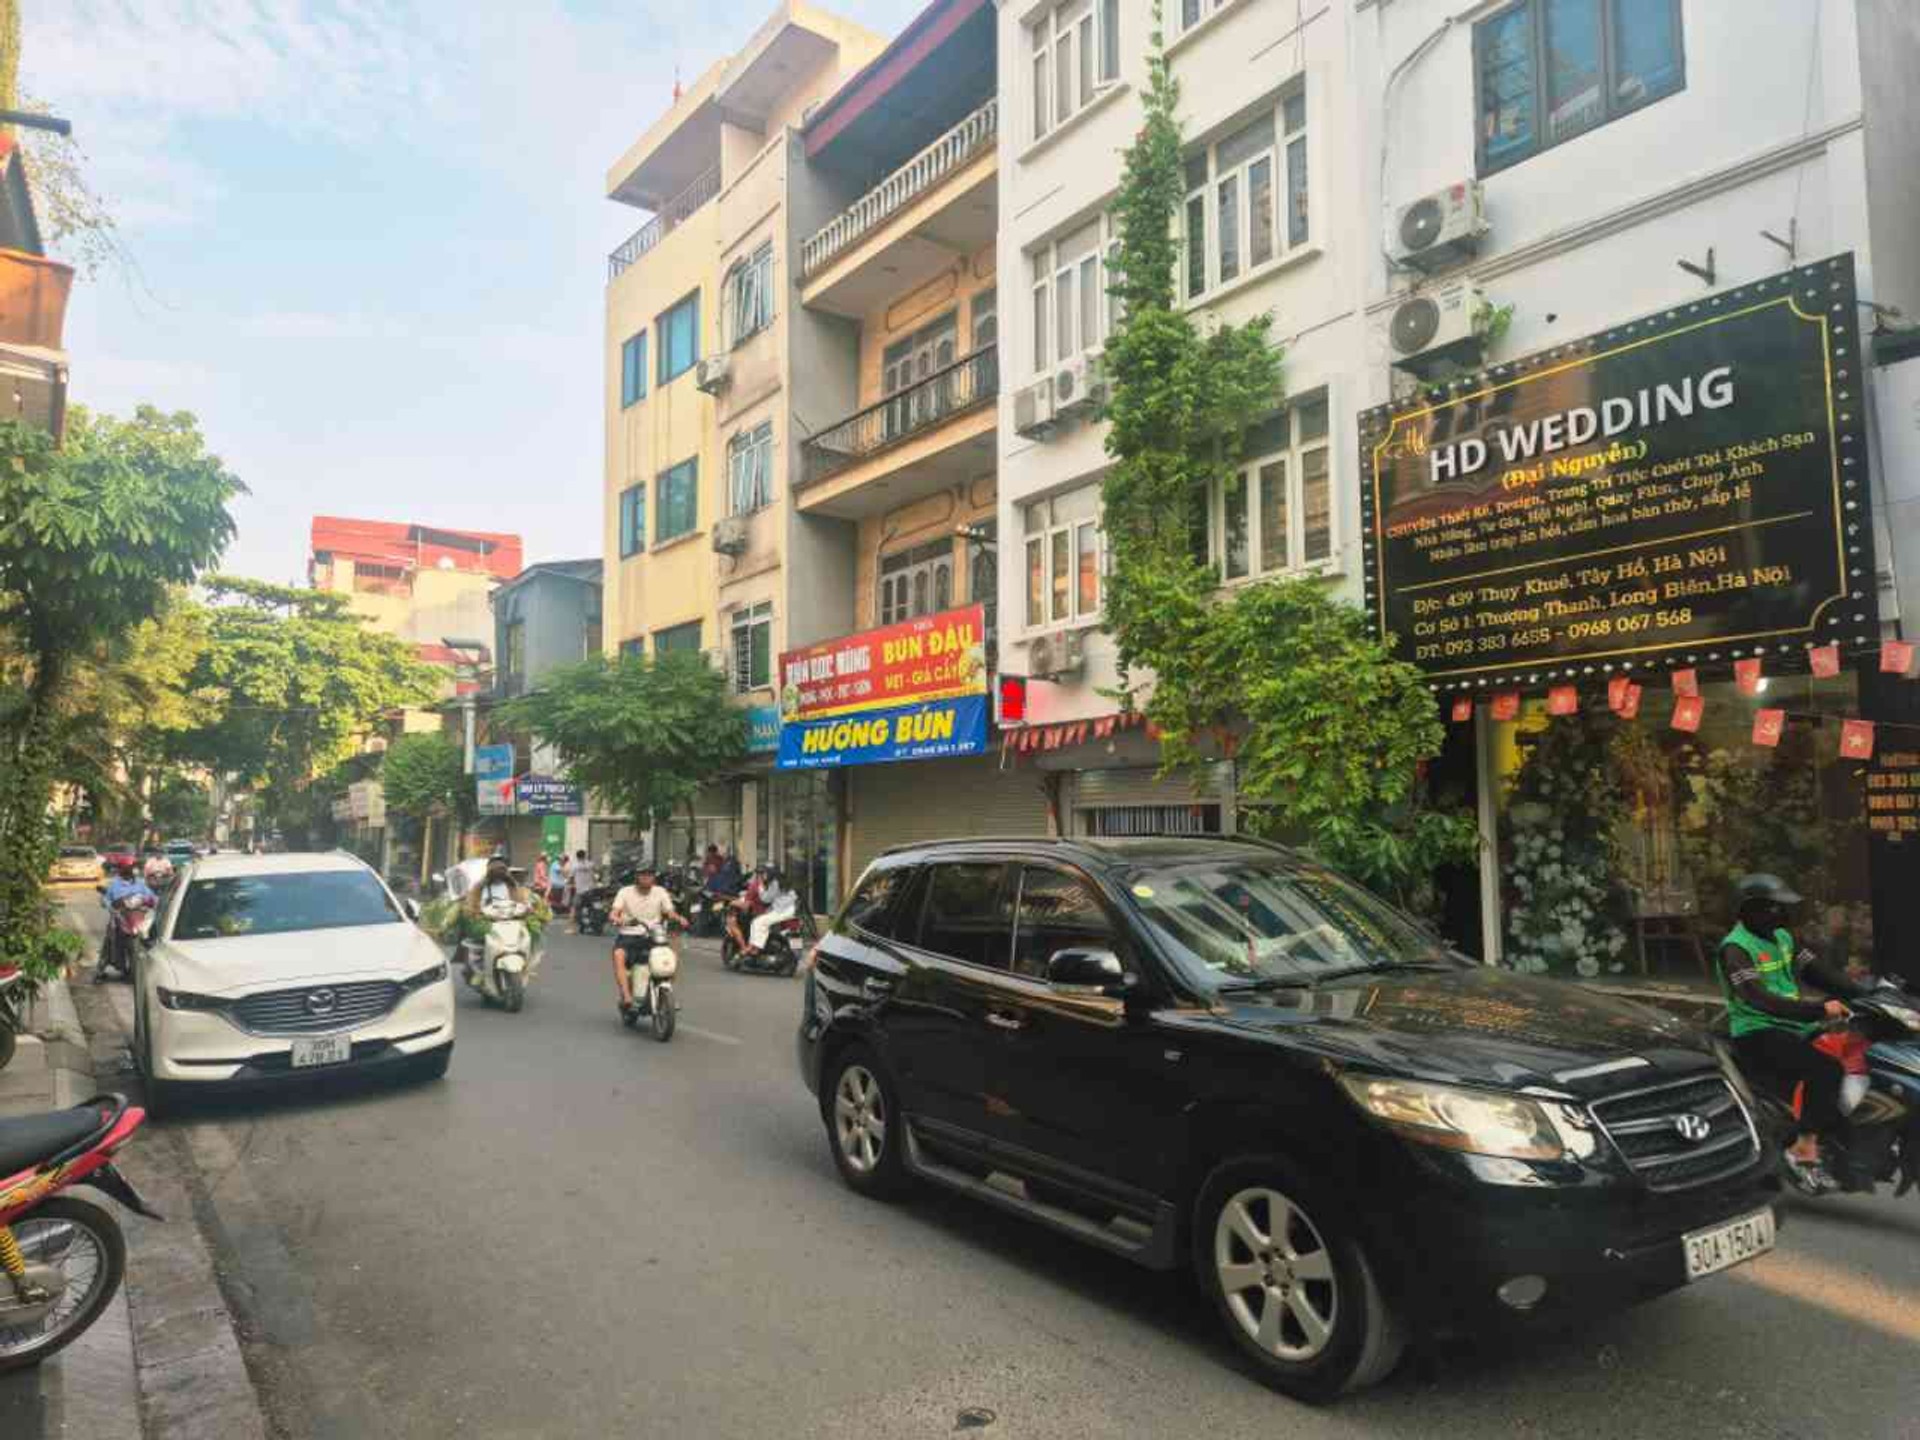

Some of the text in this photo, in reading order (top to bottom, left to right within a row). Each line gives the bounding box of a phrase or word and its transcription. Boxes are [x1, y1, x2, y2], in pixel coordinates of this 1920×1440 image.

[1430, 366, 1735, 482] HD WEDDING
[1580, 567, 1612, 586] Tây
[1653, 552, 1683, 574] Hà
[1688, 545, 1728, 568] Nội
[1609, 588, 1658, 608] Long
[1752, 564, 1792, 587] Nội
[1444, 639, 1474, 656] 093
[1568, 619, 1611, 639] 0968
[1616, 613, 1650, 632] 067
[1656, 607, 1693, 628] 568
[894, 705, 956, 744] BÚN
